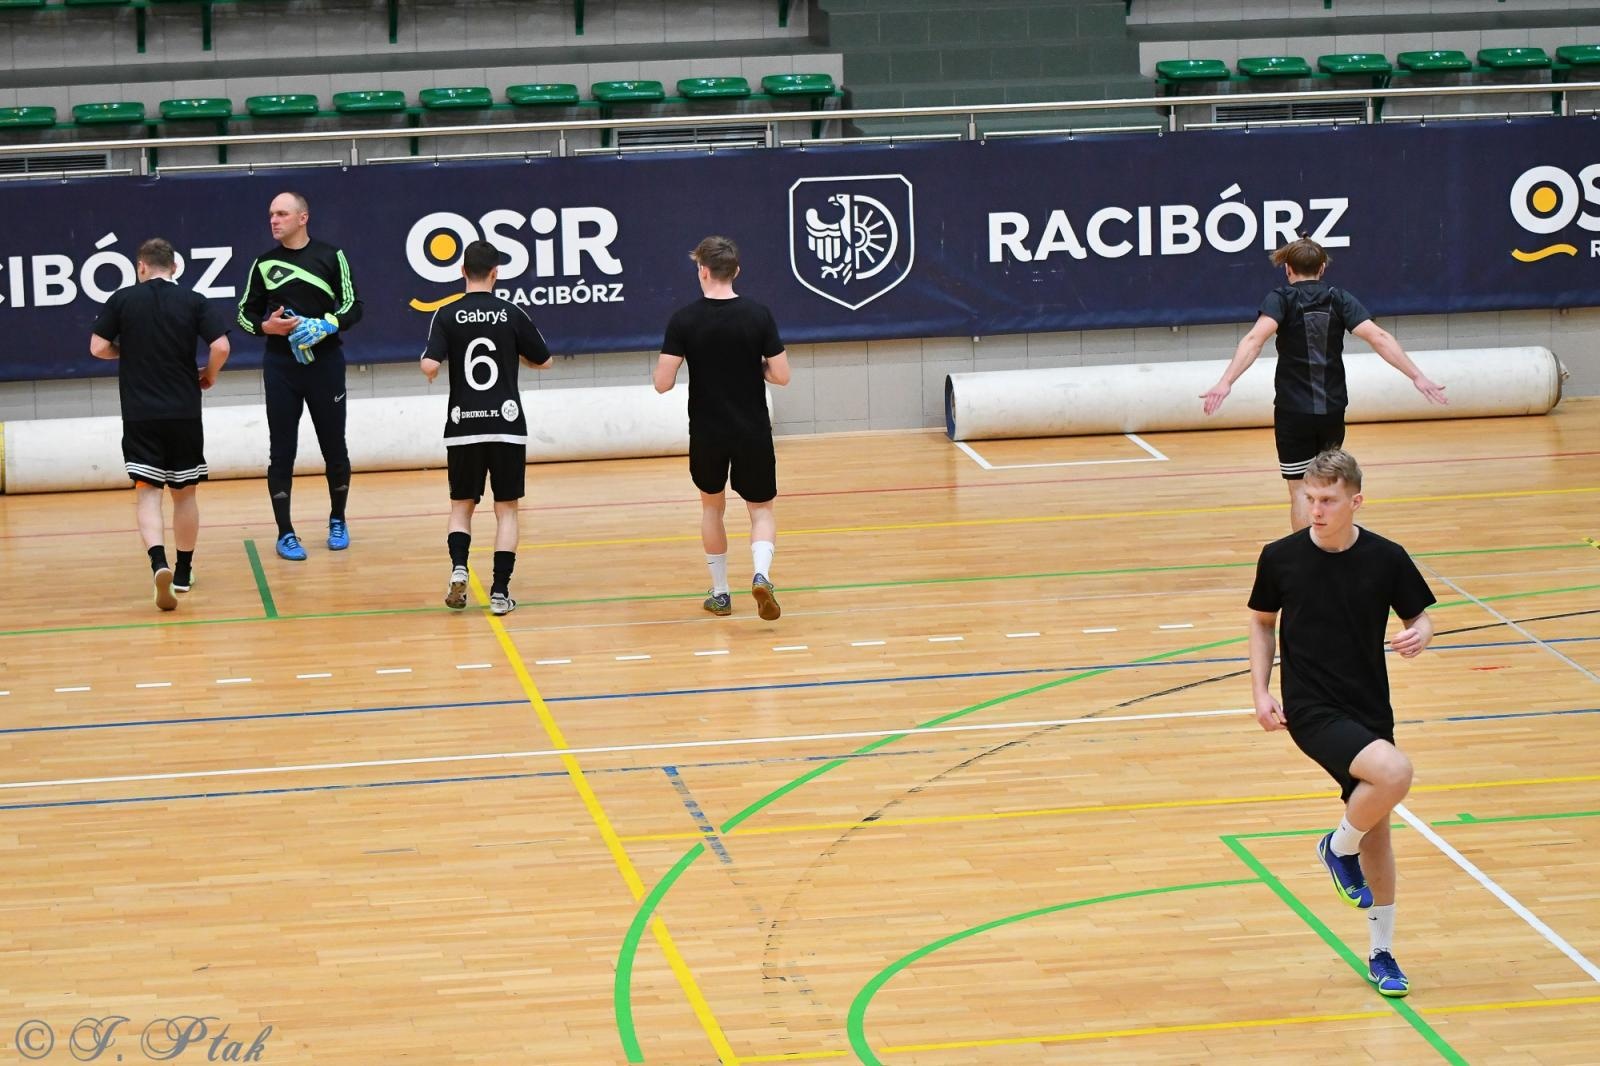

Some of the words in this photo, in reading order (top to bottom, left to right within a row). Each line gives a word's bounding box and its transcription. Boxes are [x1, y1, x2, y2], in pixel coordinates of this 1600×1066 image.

[405, 206, 623, 283] OSiR
[988, 183, 1351, 262] RACIBÓRZ
[0, 232, 236, 308] IBÓZ
[455, 309, 508, 324] Gabryś
[464, 337, 499, 391] 6
[461, 410, 500, 419] DRUKOL.PL
